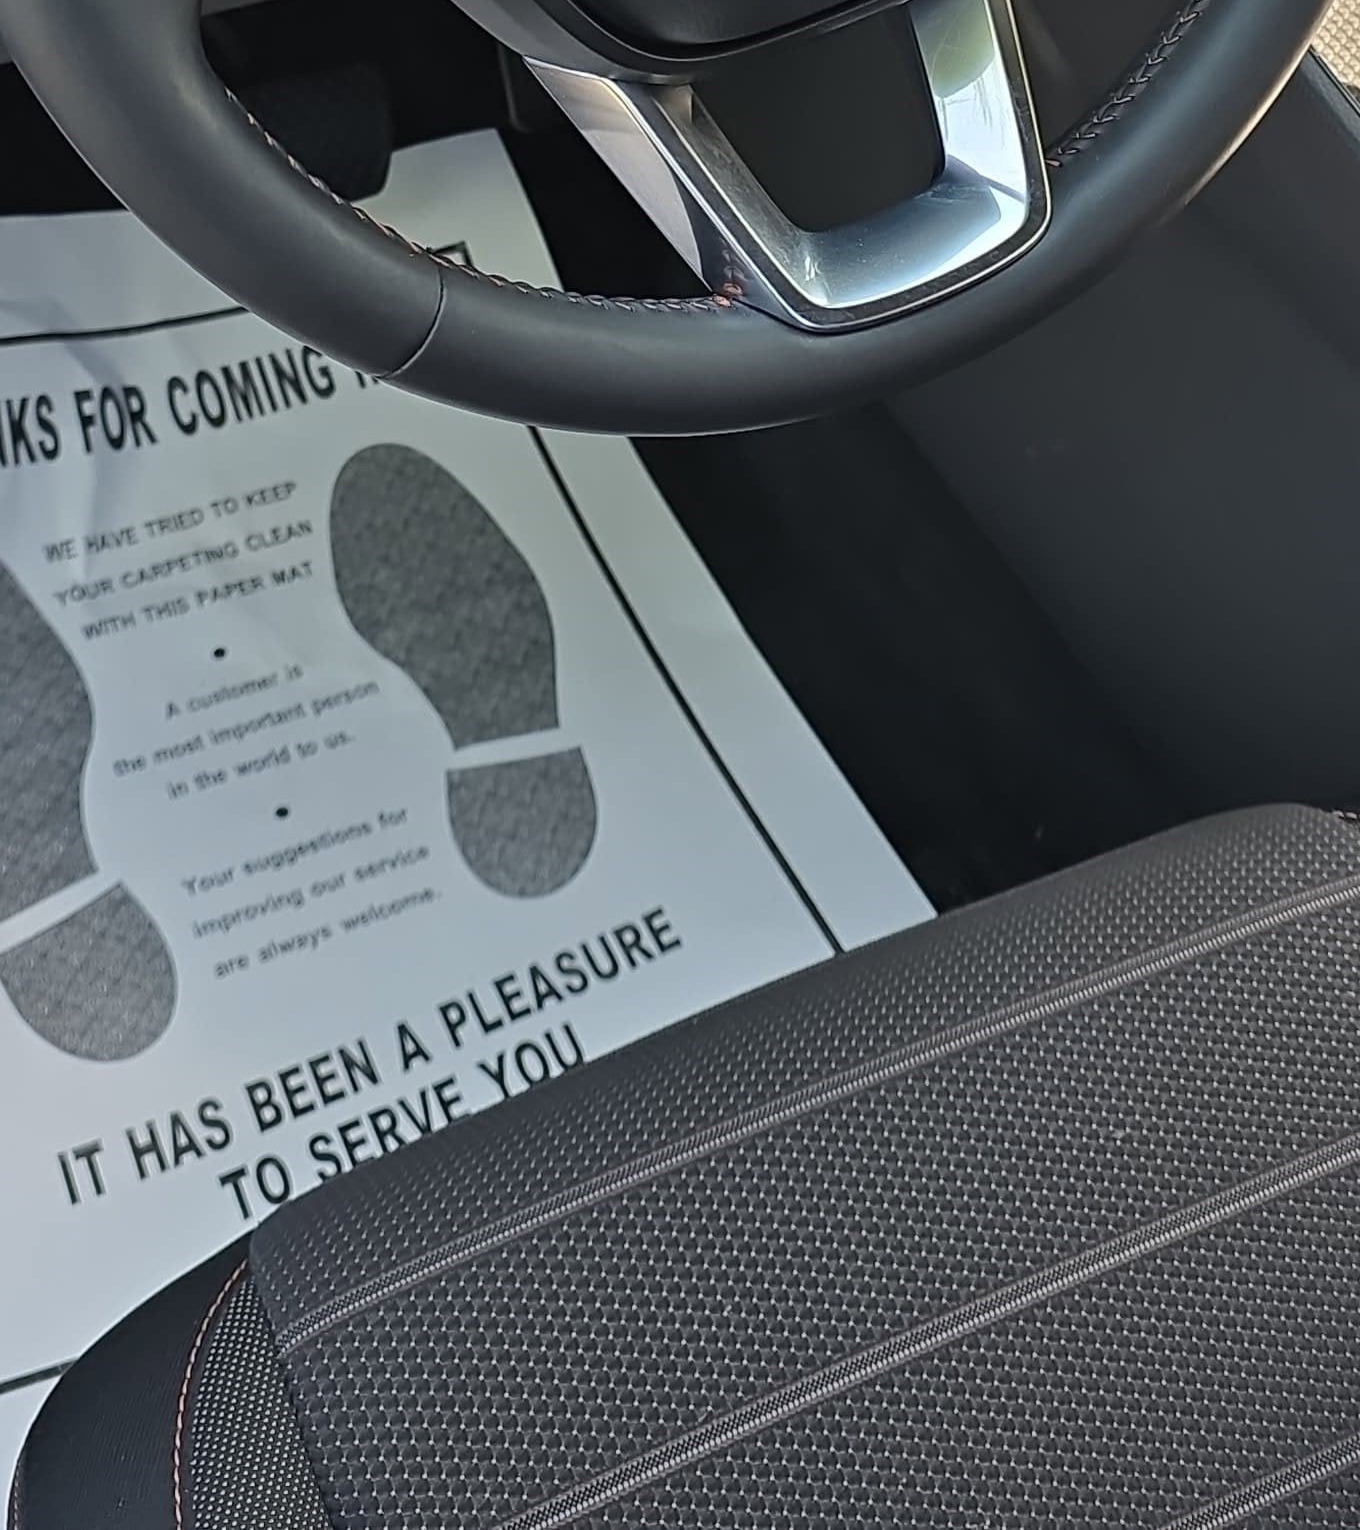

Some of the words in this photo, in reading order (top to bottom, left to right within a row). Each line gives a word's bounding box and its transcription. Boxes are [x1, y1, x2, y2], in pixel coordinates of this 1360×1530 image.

[74, 381, 160, 454] FOR
[167, 345, 336, 437] COMING
[42, 538, 78, 563] WE
[85, 525, 138, 556] HAVE
[144, 508, 206, 539] TRIED
[210, 496, 240, 520] TO
[244, 480, 297, 509] KEEP
[52, 579, 115, 607] YOUR
[120, 541, 240, 590] CARPETING
[245, 519, 313, 553] CLEAN
[82, 612, 137, 641] WITH
[144, 598, 190, 624] THIS
[195, 575, 266, 608] PAPER
[272, 561, 314, 587] MAT
[113, 754, 147, 777] the
[152, 734, 206, 763] most
[209, 702, 306, 745] important
[310, 680, 380, 716] person
[165, 701, 181, 720] A
[187, 673, 279, 712] customer
[284, 664, 304, 680] is
[167, 781, 190, 800] in
[193, 769, 228, 791] the
[234, 744, 291, 777] world
[296, 741, 318, 760] to
[182, 867, 236, 896] Your
[242, 820, 373, 876] suggestions
[377, 807, 409, 829] for
[193, 888, 305, 939] improving
[309, 874, 348, 898] our
[353, 845, 430, 882] service
[214, 953, 250, 979] are
[257, 924, 333, 965] always
[55, 1137, 108, 1206] IT
[123, 1098, 233, 1181] HAS
[244, 1037, 382, 1133] BEEN
[394, 1020, 431, 1073] A
[436, 905, 685, 1050] PLEASURE
[217, 1155, 294, 1222] TO
[308, 1076, 472, 1185] SERVE
[476, 1023, 587, 1101] YOU
